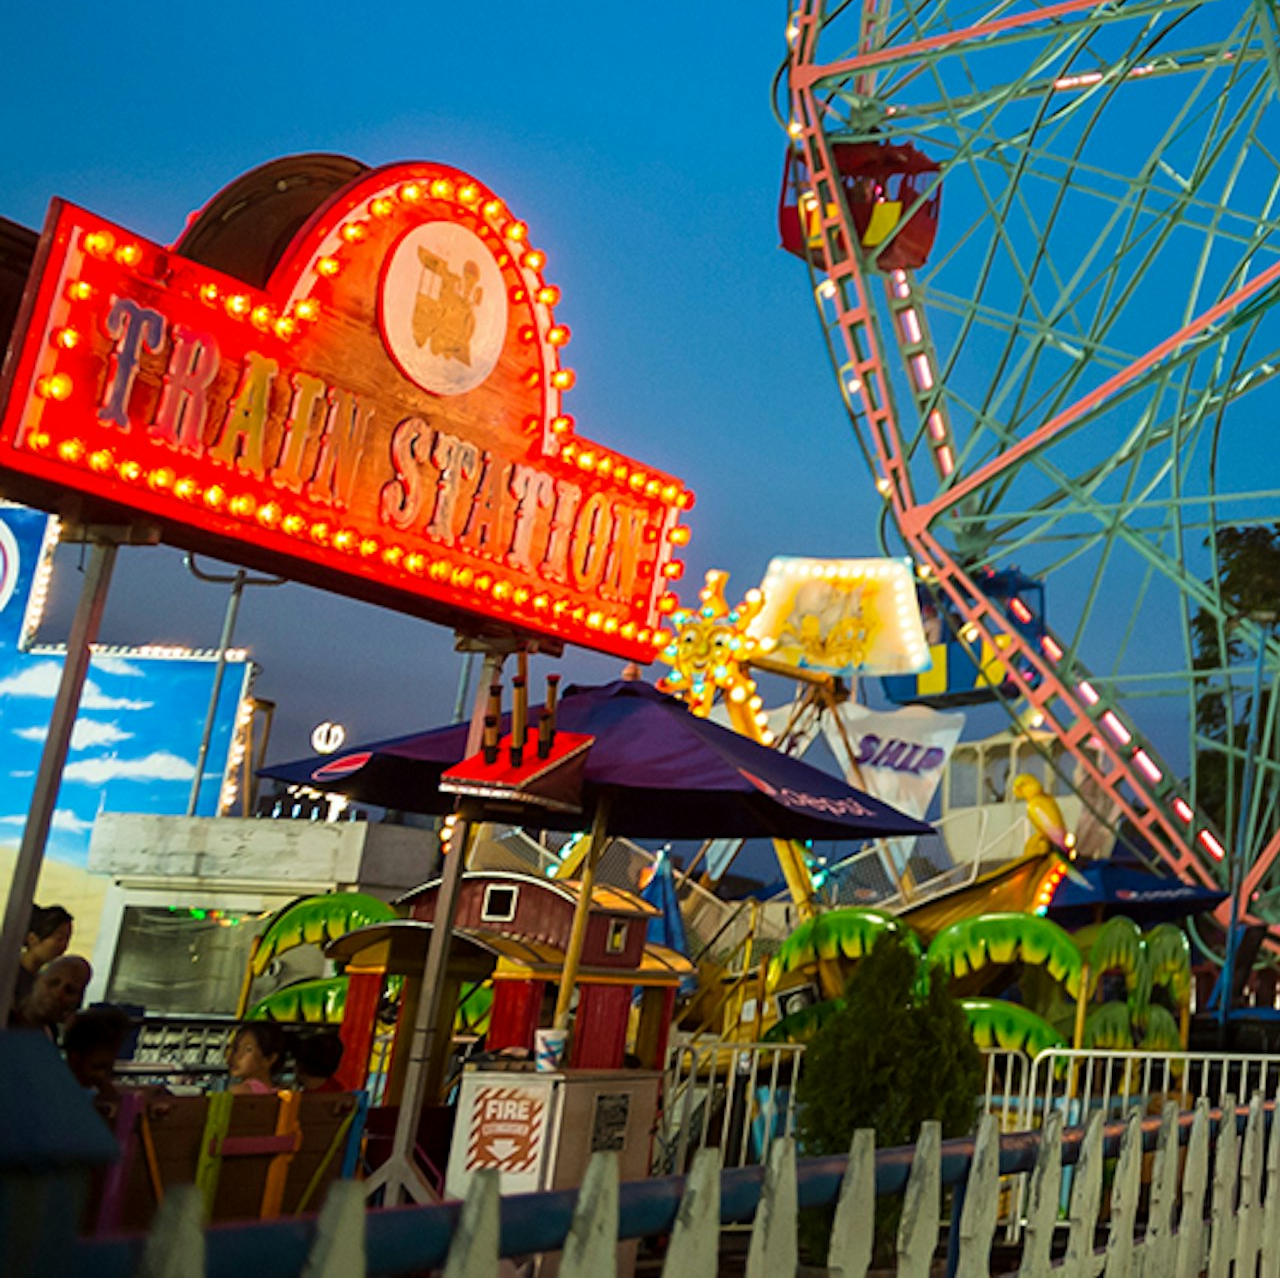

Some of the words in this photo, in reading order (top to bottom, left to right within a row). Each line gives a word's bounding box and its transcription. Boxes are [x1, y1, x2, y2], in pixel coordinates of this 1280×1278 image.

[95, 294, 375, 509] TRAIN
[381, 416, 652, 606] STATION
[856, 733, 945, 775] SHIP
[485, 1098, 530, 1121] FIRE
